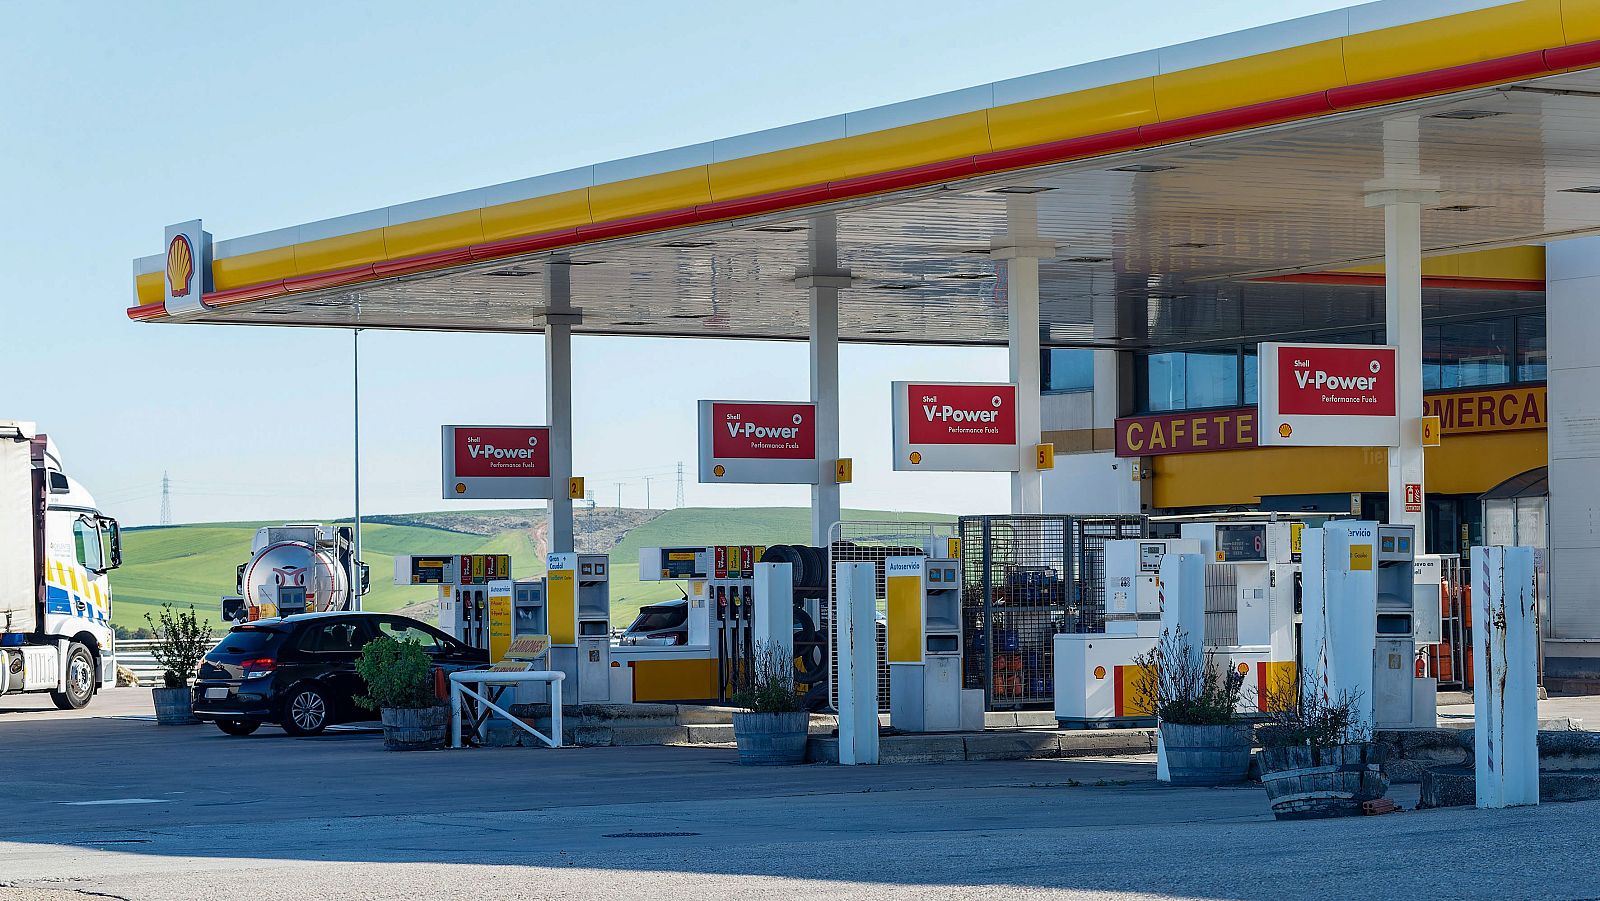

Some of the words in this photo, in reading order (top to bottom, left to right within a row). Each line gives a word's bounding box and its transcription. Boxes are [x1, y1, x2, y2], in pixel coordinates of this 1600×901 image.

[1294, 370, 1377, 390] V-Power
[1322, 395, 1360, 403] Performance
[923, 405, 998, 422] V-Power
[1424, 392, 1548, 428] MERCA
[726, 422, 799, 438] V-Power
[1126, 415, 1253, 451] CAFETE
[1424, 424, 1430, 438] 6
[468, 444, 534, 458] V-Power
[1040, 450, 1045, 464] 5
[838, 464, 844, 476] 4
[571, 482, 577, 493] 2
[1254, 535, 1262, 552] 6
[890, 562, 920, 572] Autoservicio
